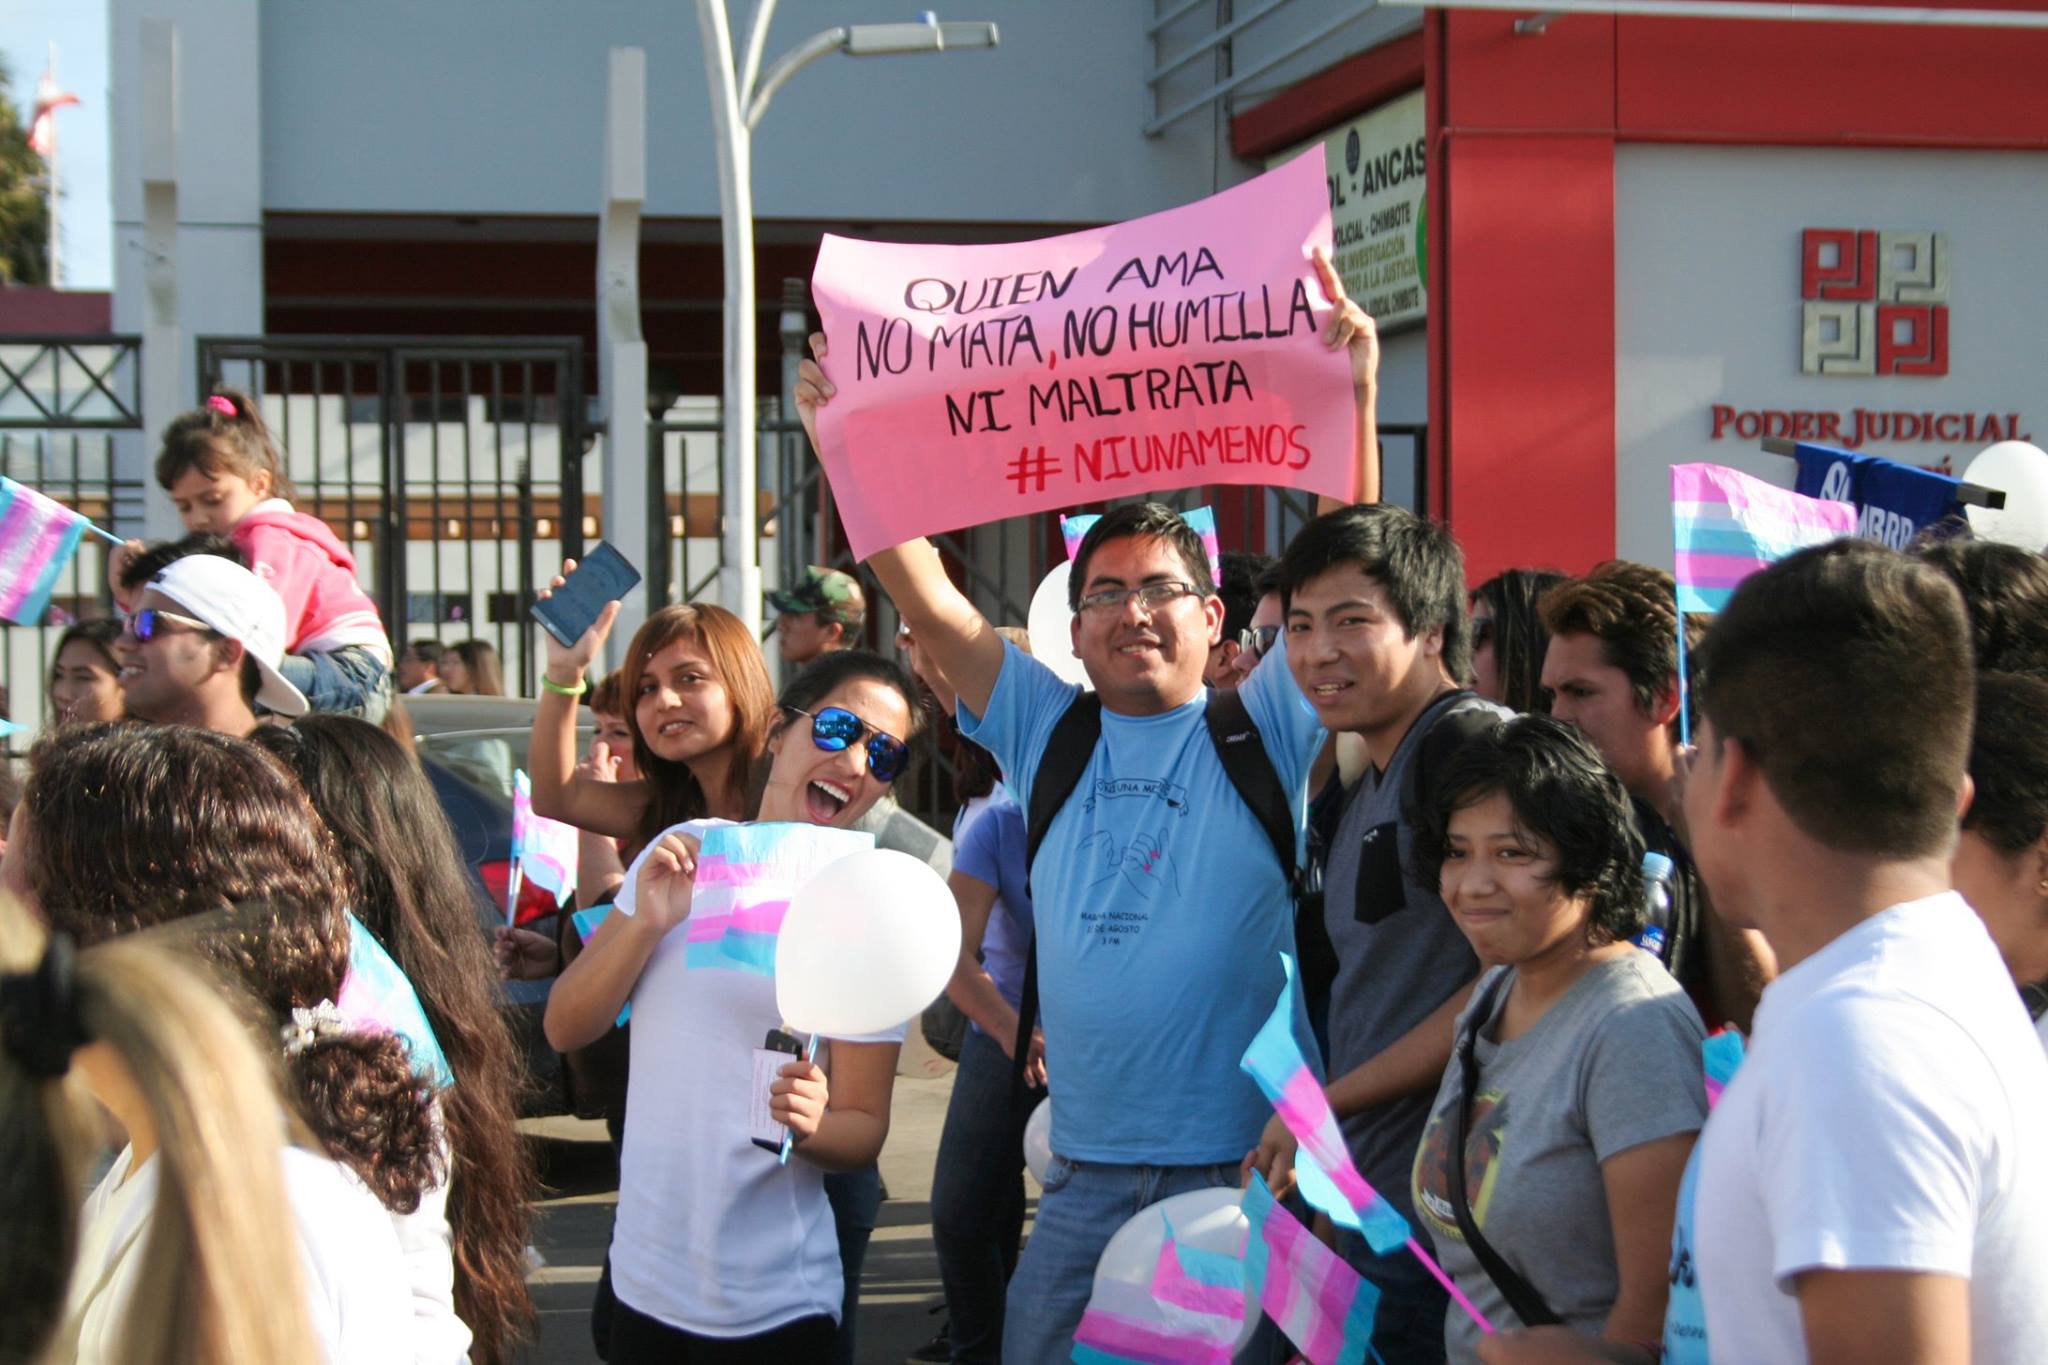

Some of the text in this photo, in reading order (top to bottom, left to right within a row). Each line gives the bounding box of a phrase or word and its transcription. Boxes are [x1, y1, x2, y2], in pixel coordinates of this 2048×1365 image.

[1370, 200, 1410, 236] CHIMBOTE
[904, 247, 1224, 315] QUIEN AMA
[856, 317, 913, 380] NO
[1063, 305, 1117, 358] NO
[1128, 278, 1317, 352] HUMILLA
[946, 360, 1253, 436] NI MALTRATA
